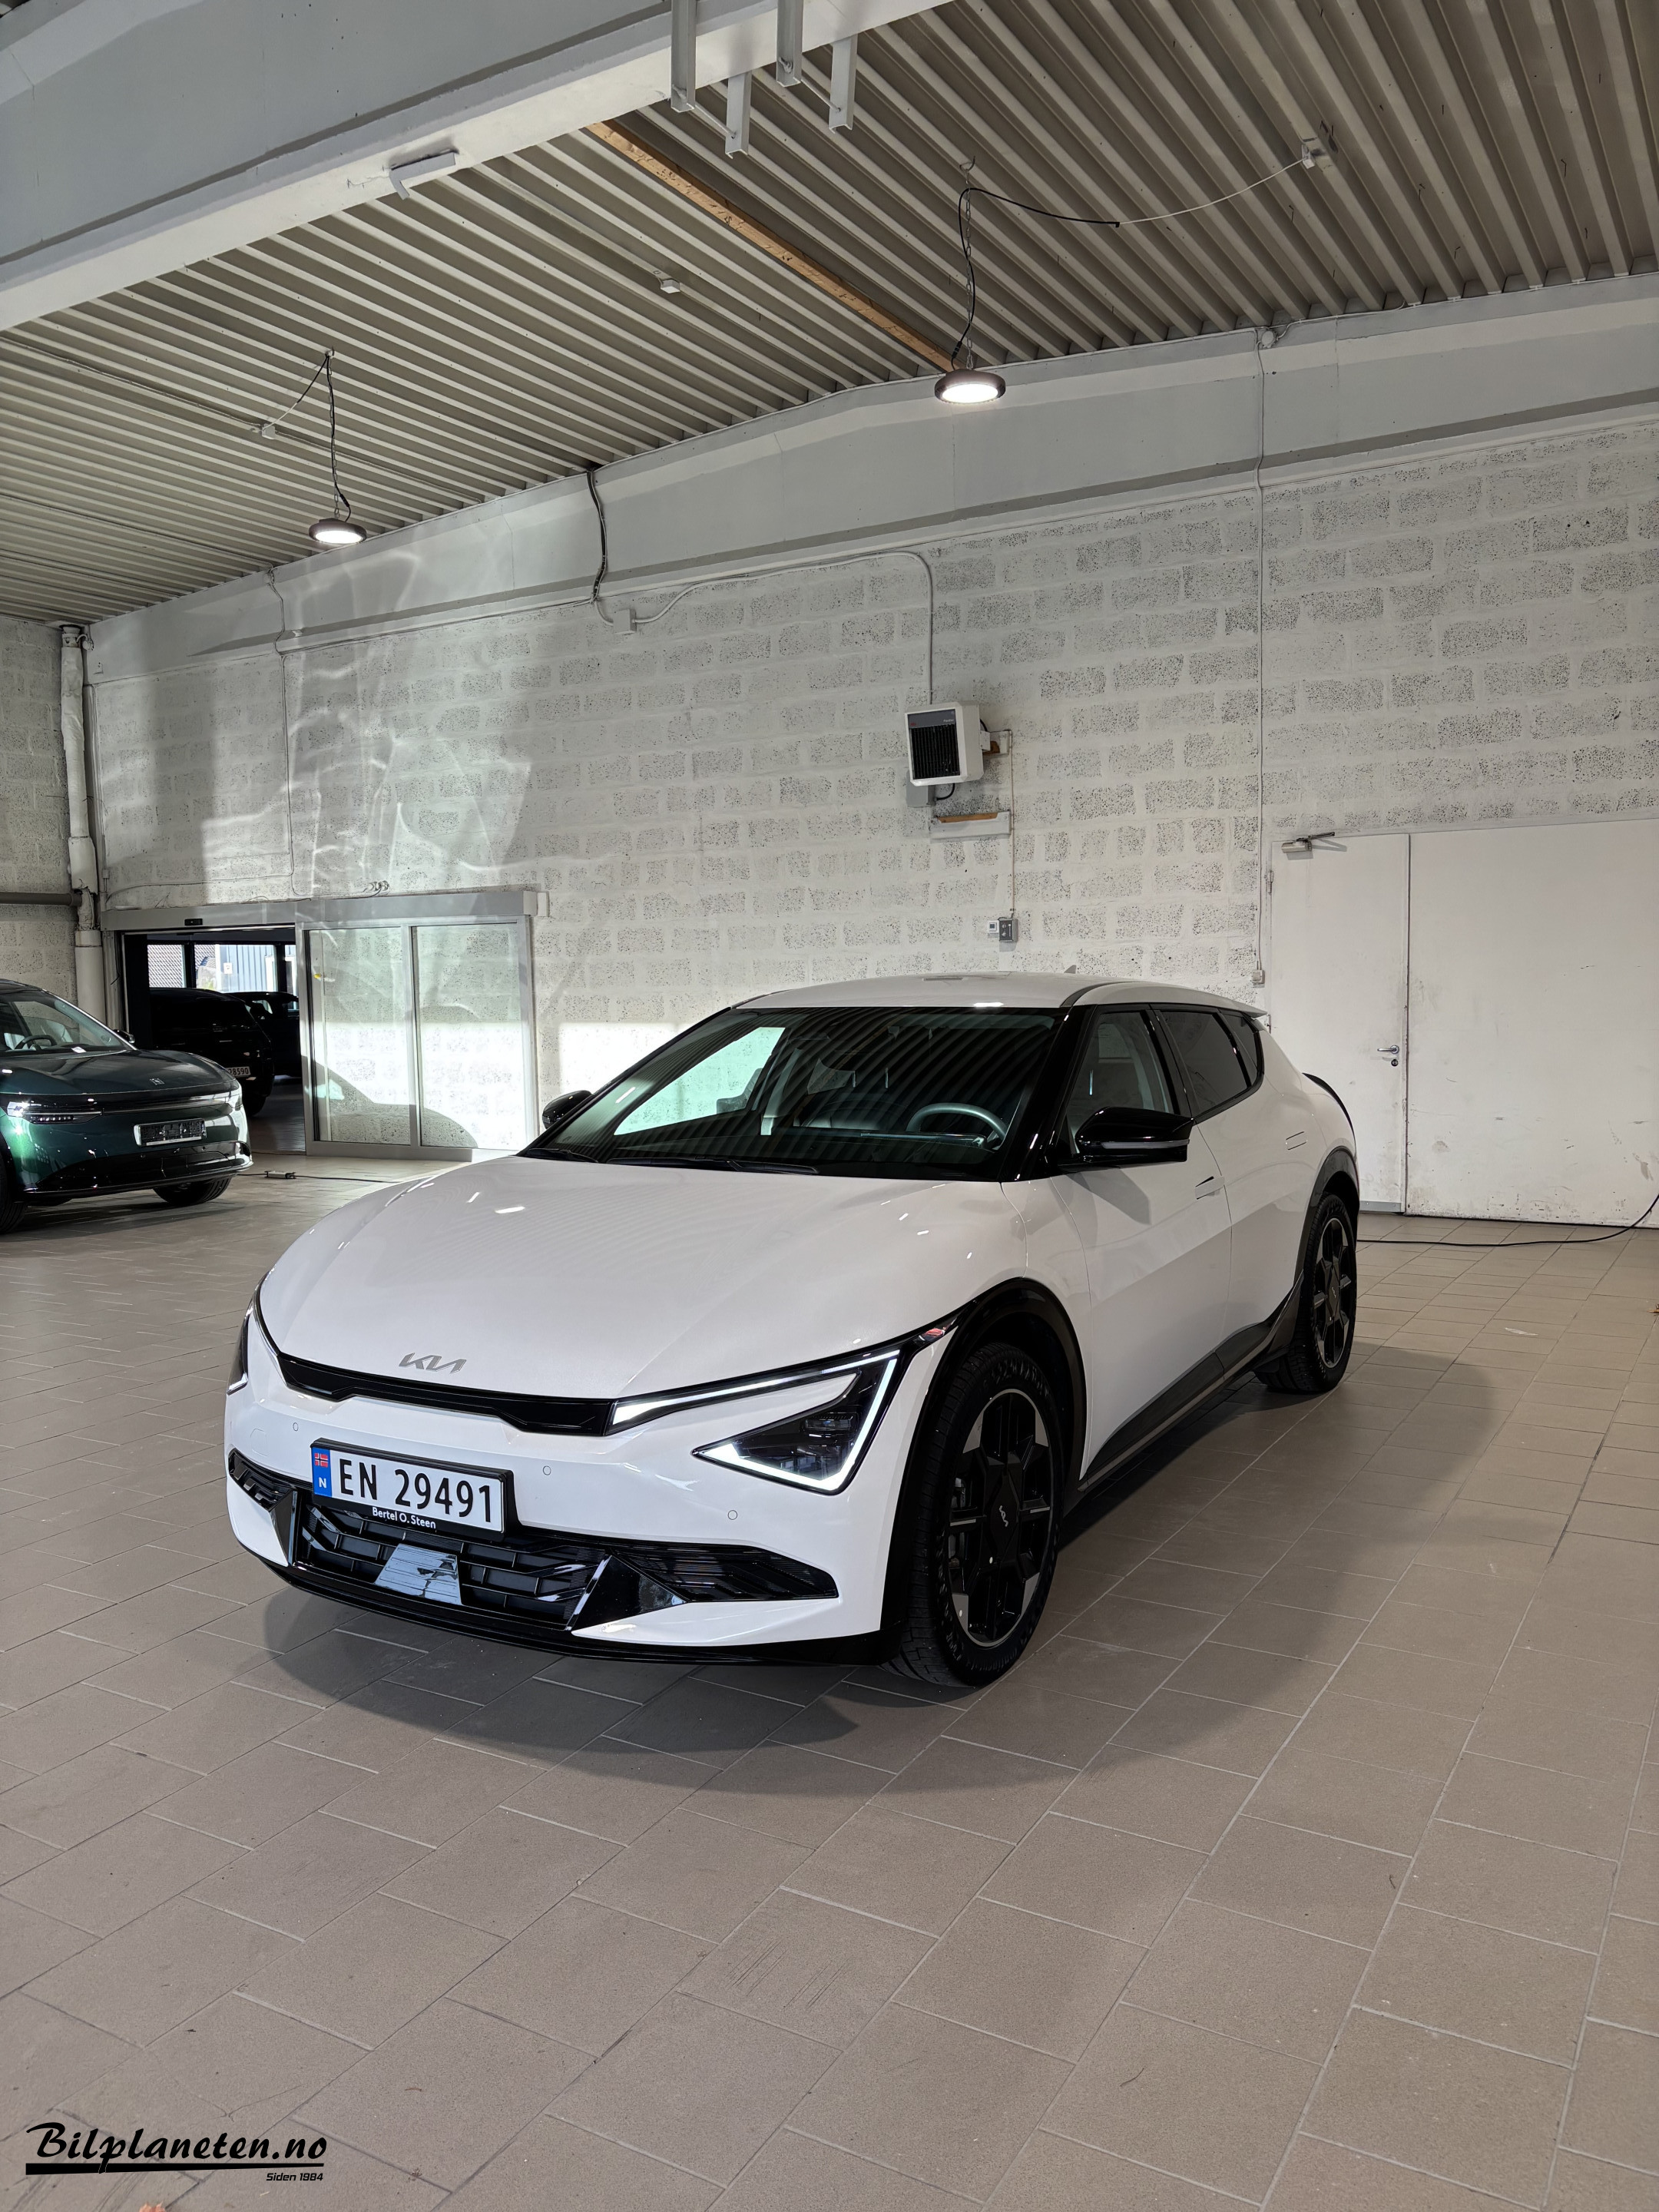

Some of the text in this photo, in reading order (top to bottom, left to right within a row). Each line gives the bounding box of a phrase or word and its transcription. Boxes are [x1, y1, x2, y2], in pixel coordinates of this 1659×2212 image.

[399, 1353, 466, 1374] KIA
[318, 1476, 327, 1488] N
[339, 1458, 492, 1523] EN 29491
[372, 1506, 436, 1529] Bertel O. Steen
